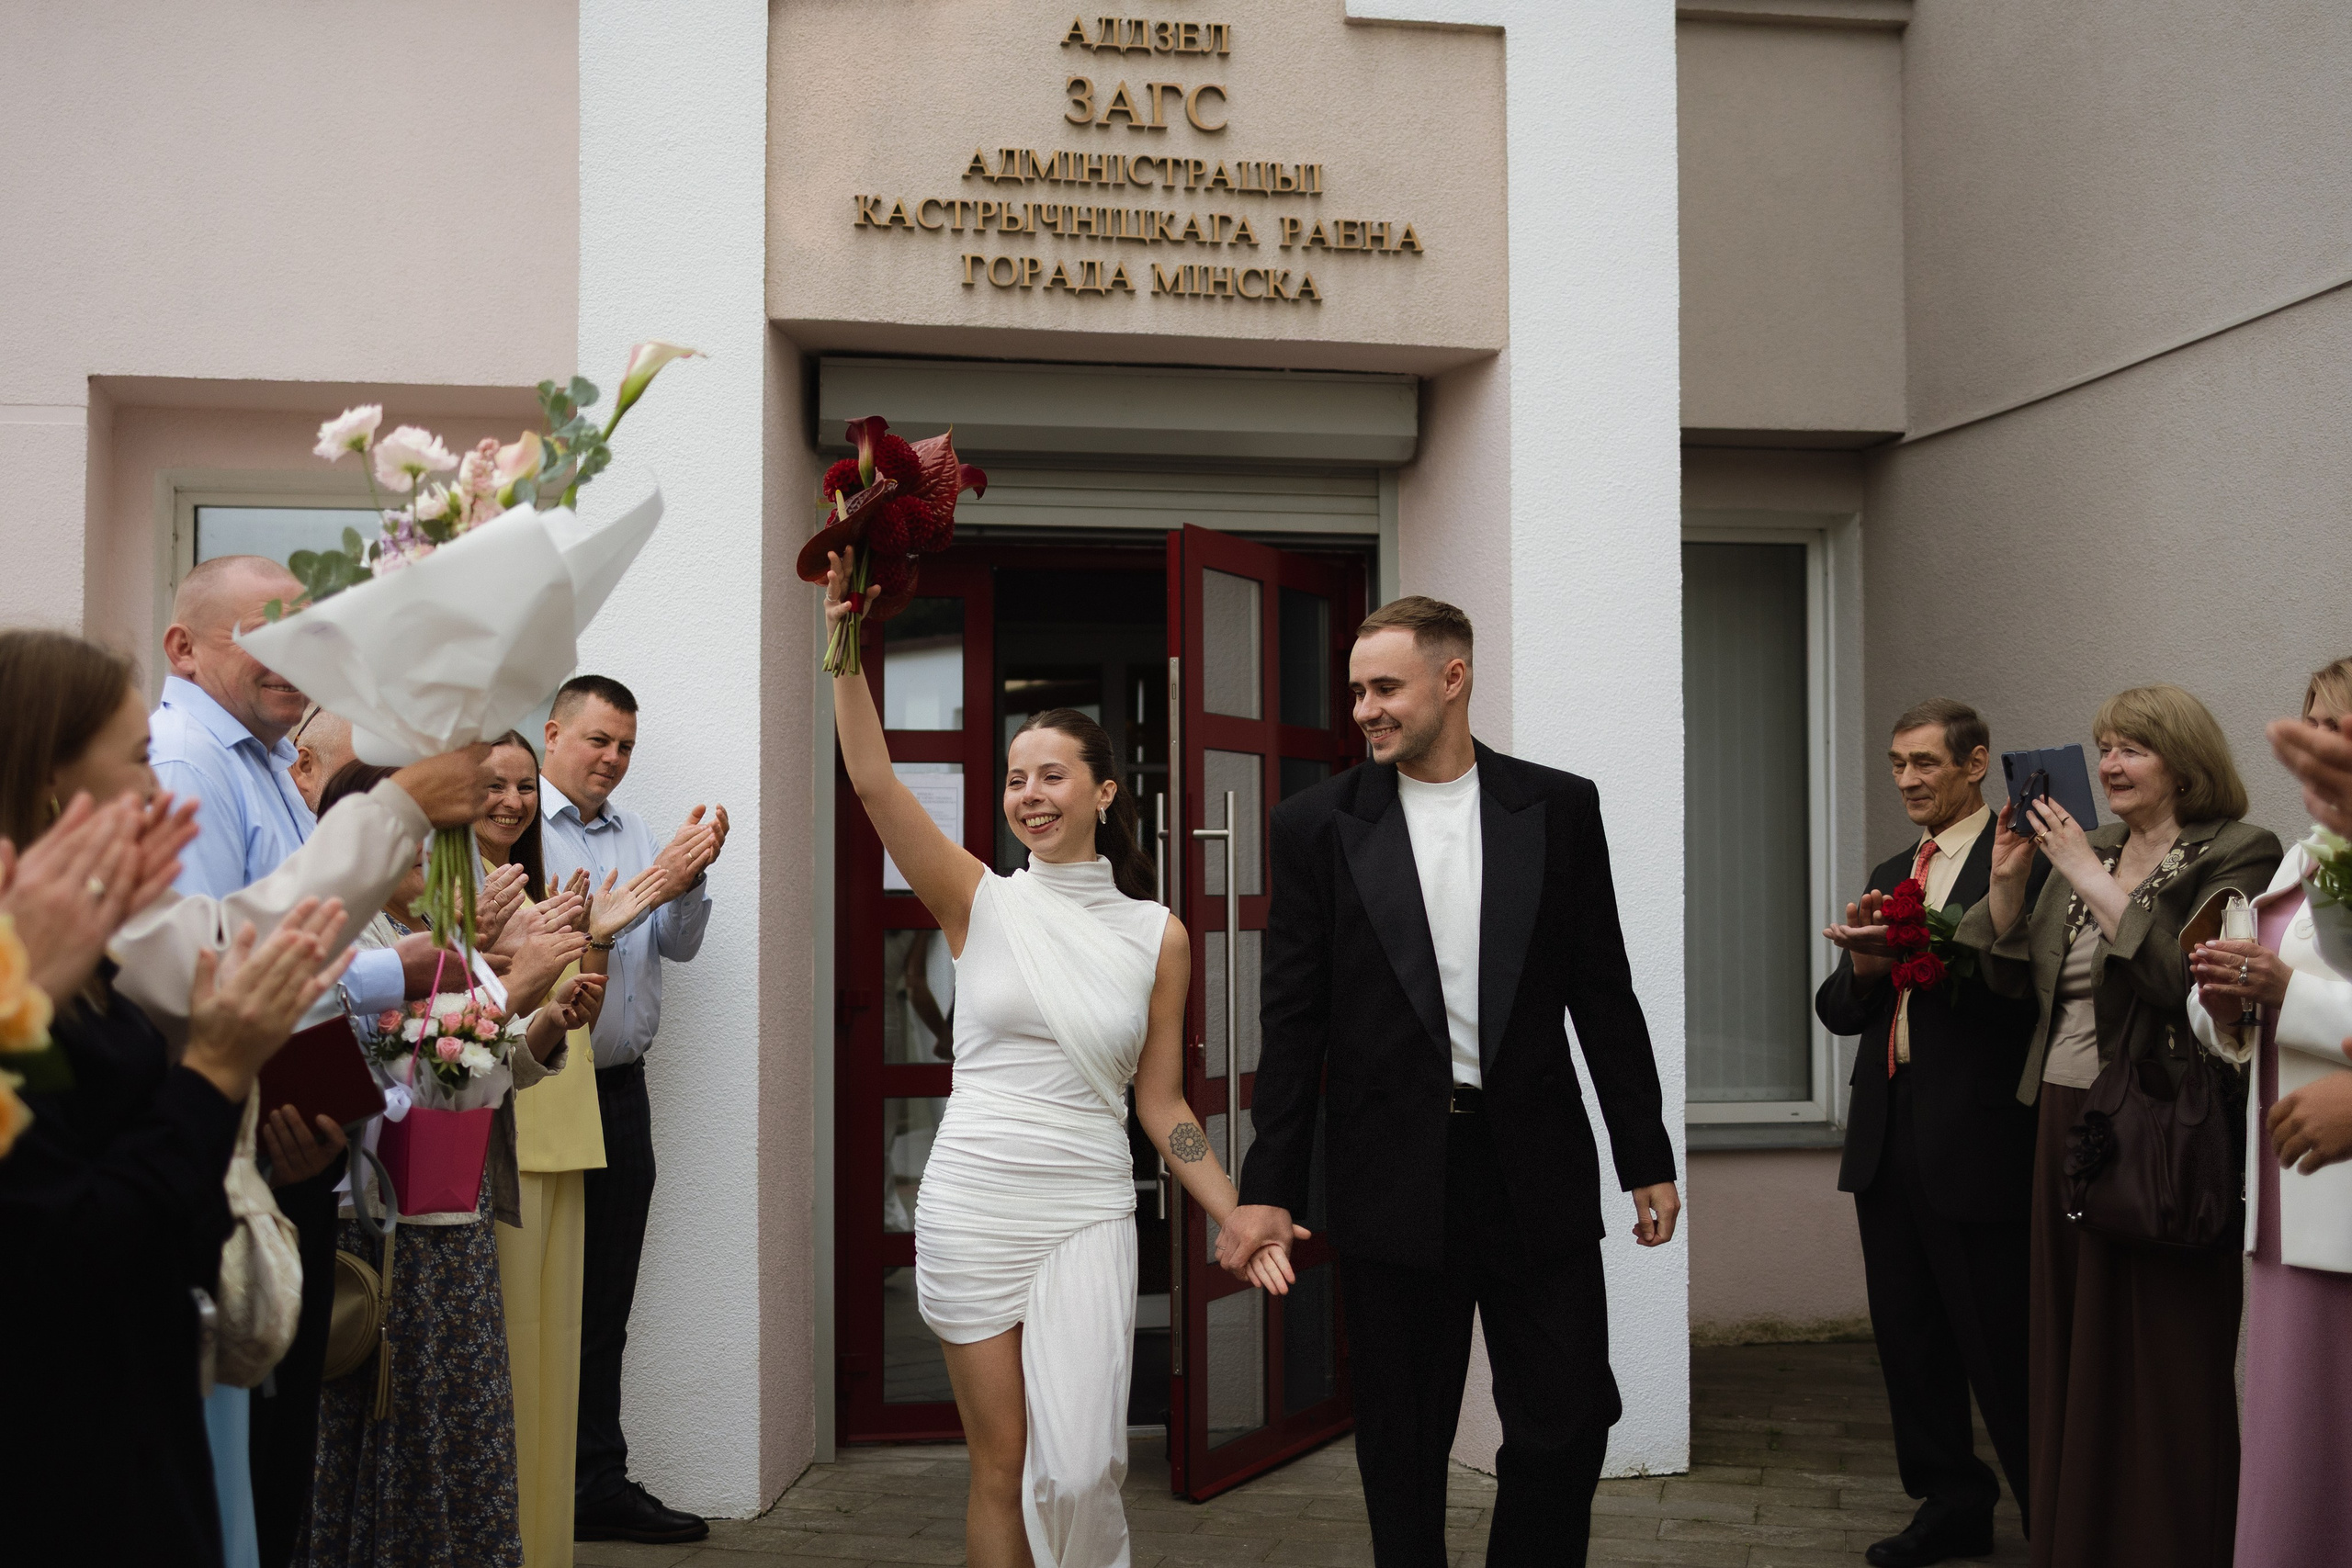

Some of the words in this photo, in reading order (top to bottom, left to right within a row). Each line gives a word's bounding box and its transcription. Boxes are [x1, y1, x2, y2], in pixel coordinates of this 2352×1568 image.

[1060, 14, 1231, 56] АДДЗЕЛ
[1064, 75, 1229, 131] ЗАГС
[961, 146, 1323, 197] АДМІНІСТРАЦЫІ
[854, 194, 1261, 246] КАСТРЫЧНІЦКАГА
[1279, 216, 1424, 254] РАЕНА
[961, 253, 1136, 295] ГОРАДА
[1150, 263, 1323, 302] МІНСКА
